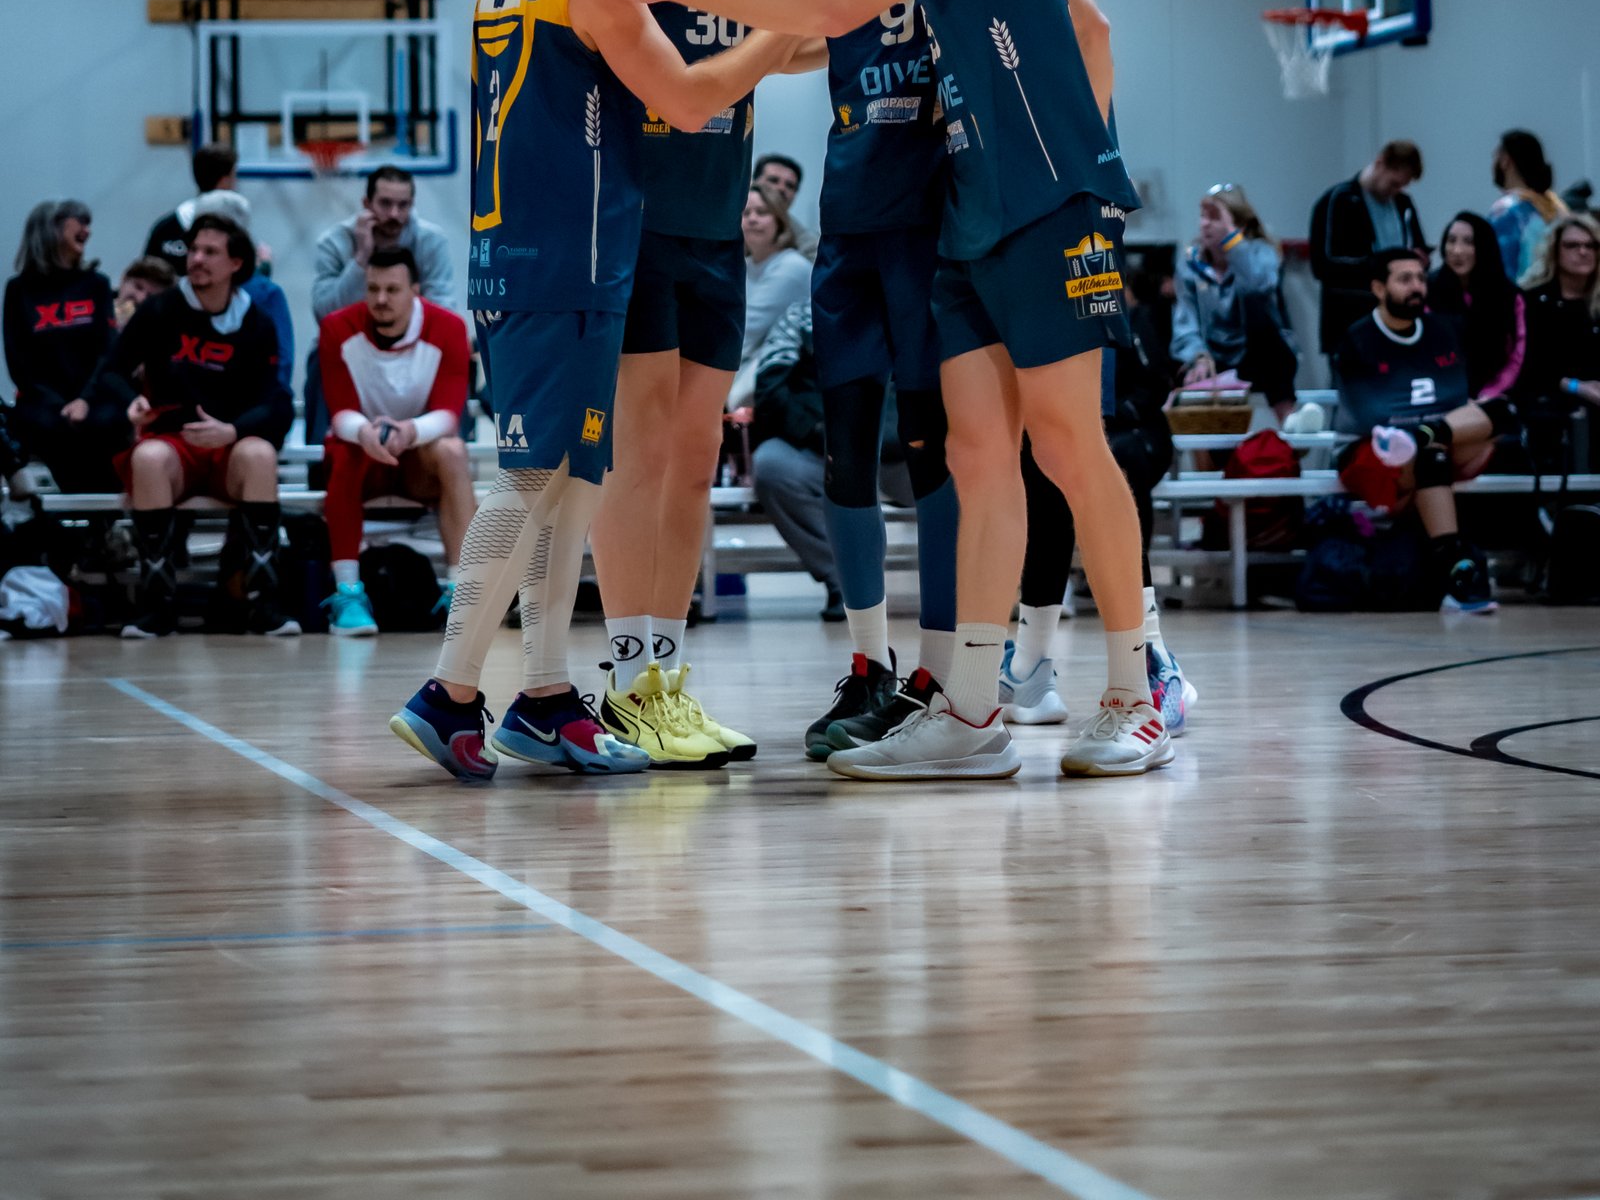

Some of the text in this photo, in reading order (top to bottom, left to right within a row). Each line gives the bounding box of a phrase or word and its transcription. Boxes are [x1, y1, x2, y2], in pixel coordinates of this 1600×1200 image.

[686, 6, 746, 47] 30
[860, 55, 930, 96] DIVE
[642, 123, 671, 134] ADGER
[469, 278, 506, 296] OVUS
[34, 299, 95, 331] XP
[1089, 300, 1118, 314] DIVE
[173, 333, 234, 364] XP
[1410, 377, 1436, 406] 2
[494, 413, 528, 448] LA
